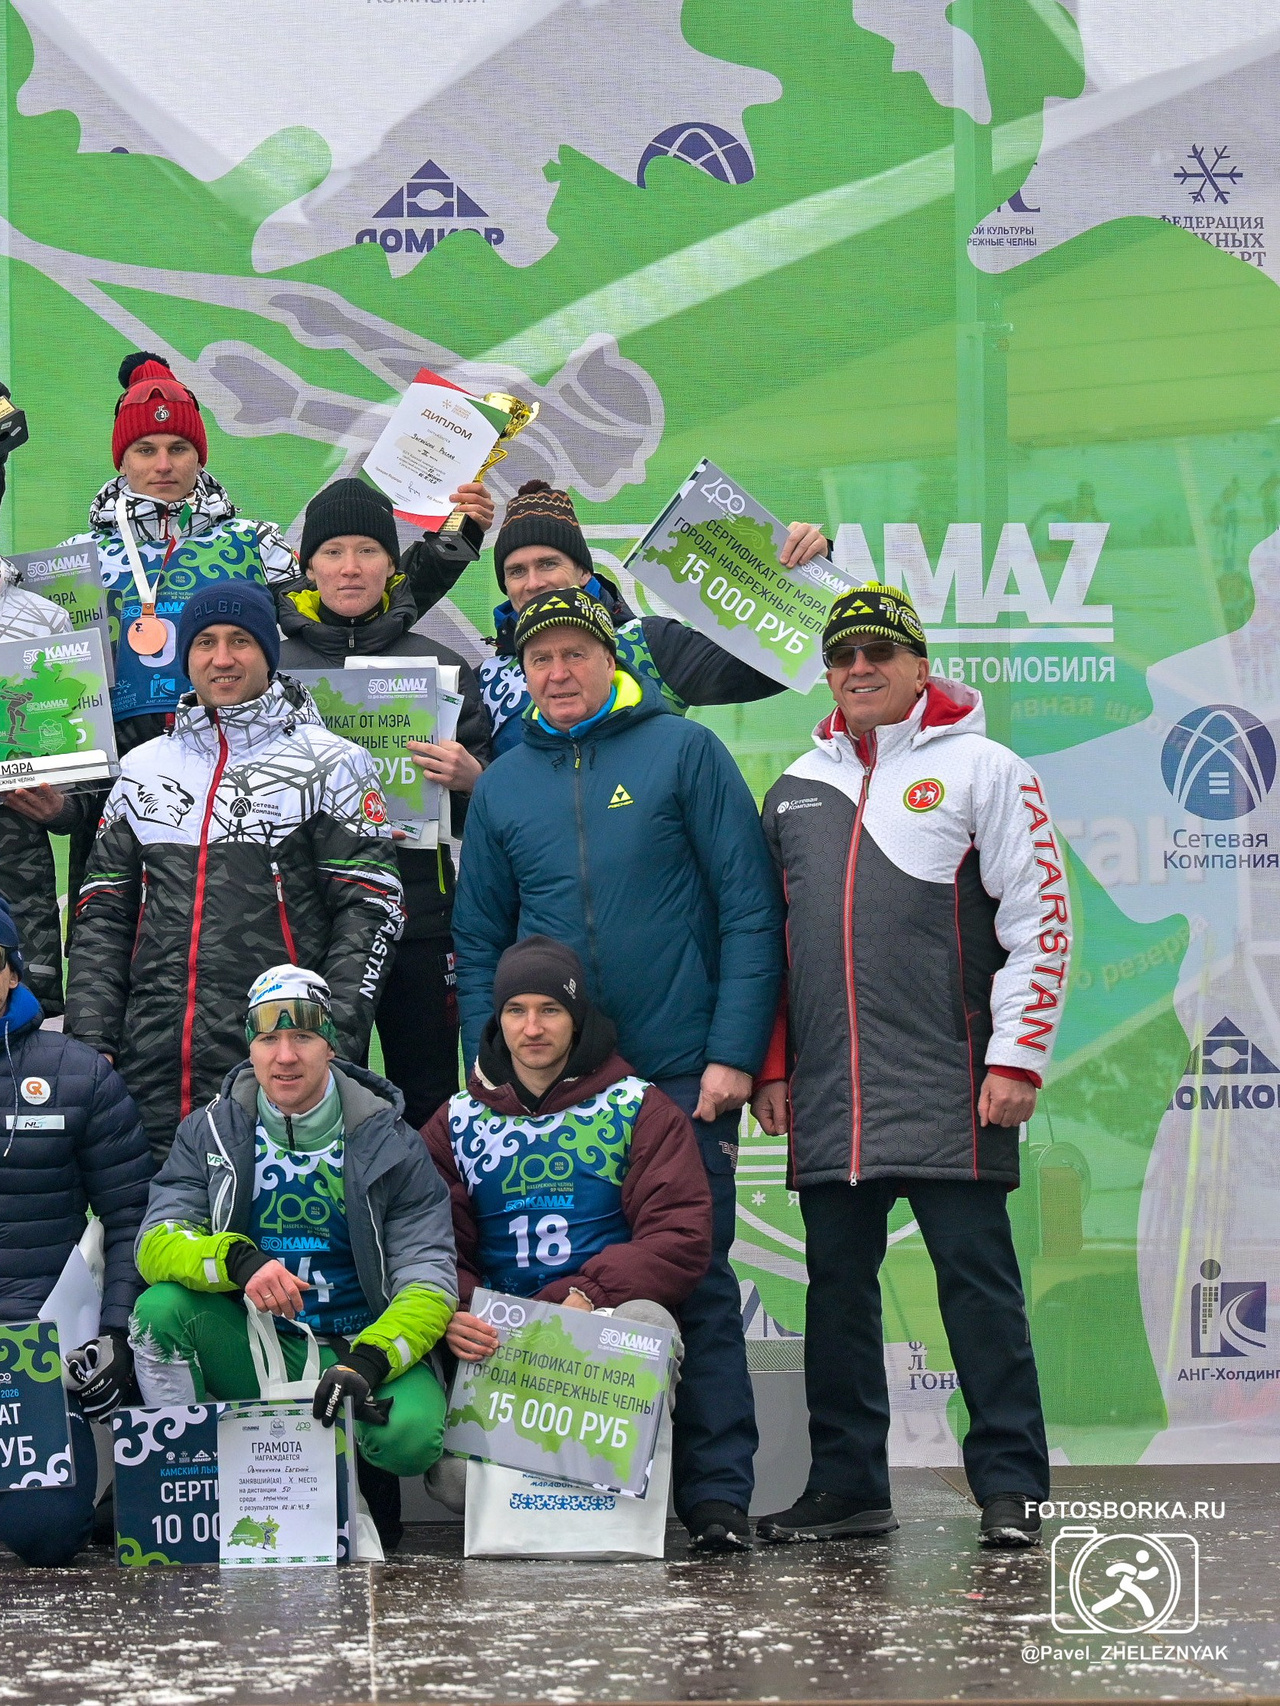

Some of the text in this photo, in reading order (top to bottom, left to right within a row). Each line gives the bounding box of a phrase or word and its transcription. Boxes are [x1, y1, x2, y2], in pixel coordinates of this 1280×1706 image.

[987, 226, 1034, 235] КУЛЬТУРЫ
[421, 409, 473, 440] ДИПЛОМ
[674, 517, 716, 559] ГОРОДА
[717, 556, 798, 621] НАБЕРЕЖНЫЕ
[706, 519, 778, 582] СЕРТИФИКАТ
[777, 578, 793, 593] ОТ
[793, 589, 827, 618] МЭРА
[818, 522, 1114, 625] AMAZ
[194, 600, 243, 619] ALGA
[679, 553, 710, 585] 15
[706, 576, 756, 622] 000
[755, 612, 810, 655] РУБ
[69, 607, 103, 625] ЕЛНЫ
[928, 656, 1116, 683] АВТОМОБИЛЯ
[359, 714, 375, 728] ОТ
[378, 714, 411, 728] МЭРА
[348, 735, 389, 749] ЖНЫЕ
[1, 761, 34, 775] МЭРА
[1173, 829, 1269, 848] Сетевая
[1163, 850, 1280, 869] Компания
[1015, 775, 1072, 1054] TATARSTAN
[1166, 1085, 1280, 1111] ОМКО
[508, 1214, 572, 1268] 18
[496, 1345, 582, 1376] СЕРТИФИКАТ
[584, 1363, 601, 1379] ОТ
[602, 1368, 635, 1388] МЭРА
[1177, 1366, 1280, 1382] АНГ-Холдинг
[1, 1388, 20, 1398] 2026
[465, 1362, 655, 1415] ГОРОДА НАБЕРЕЖНЫЕ ЧЕЛНЫ
[488, 1391, 630, 1449] 15 000 РУБ
[252, 1441, 302, 1453] ГРАМОТА
[255, 1454, 300, 1462] НАГРАЖДАЕТСЯ
[160, 1465, 199, 1477] КАМСКИЙ
[151, 1514, 182, 1544] 10
